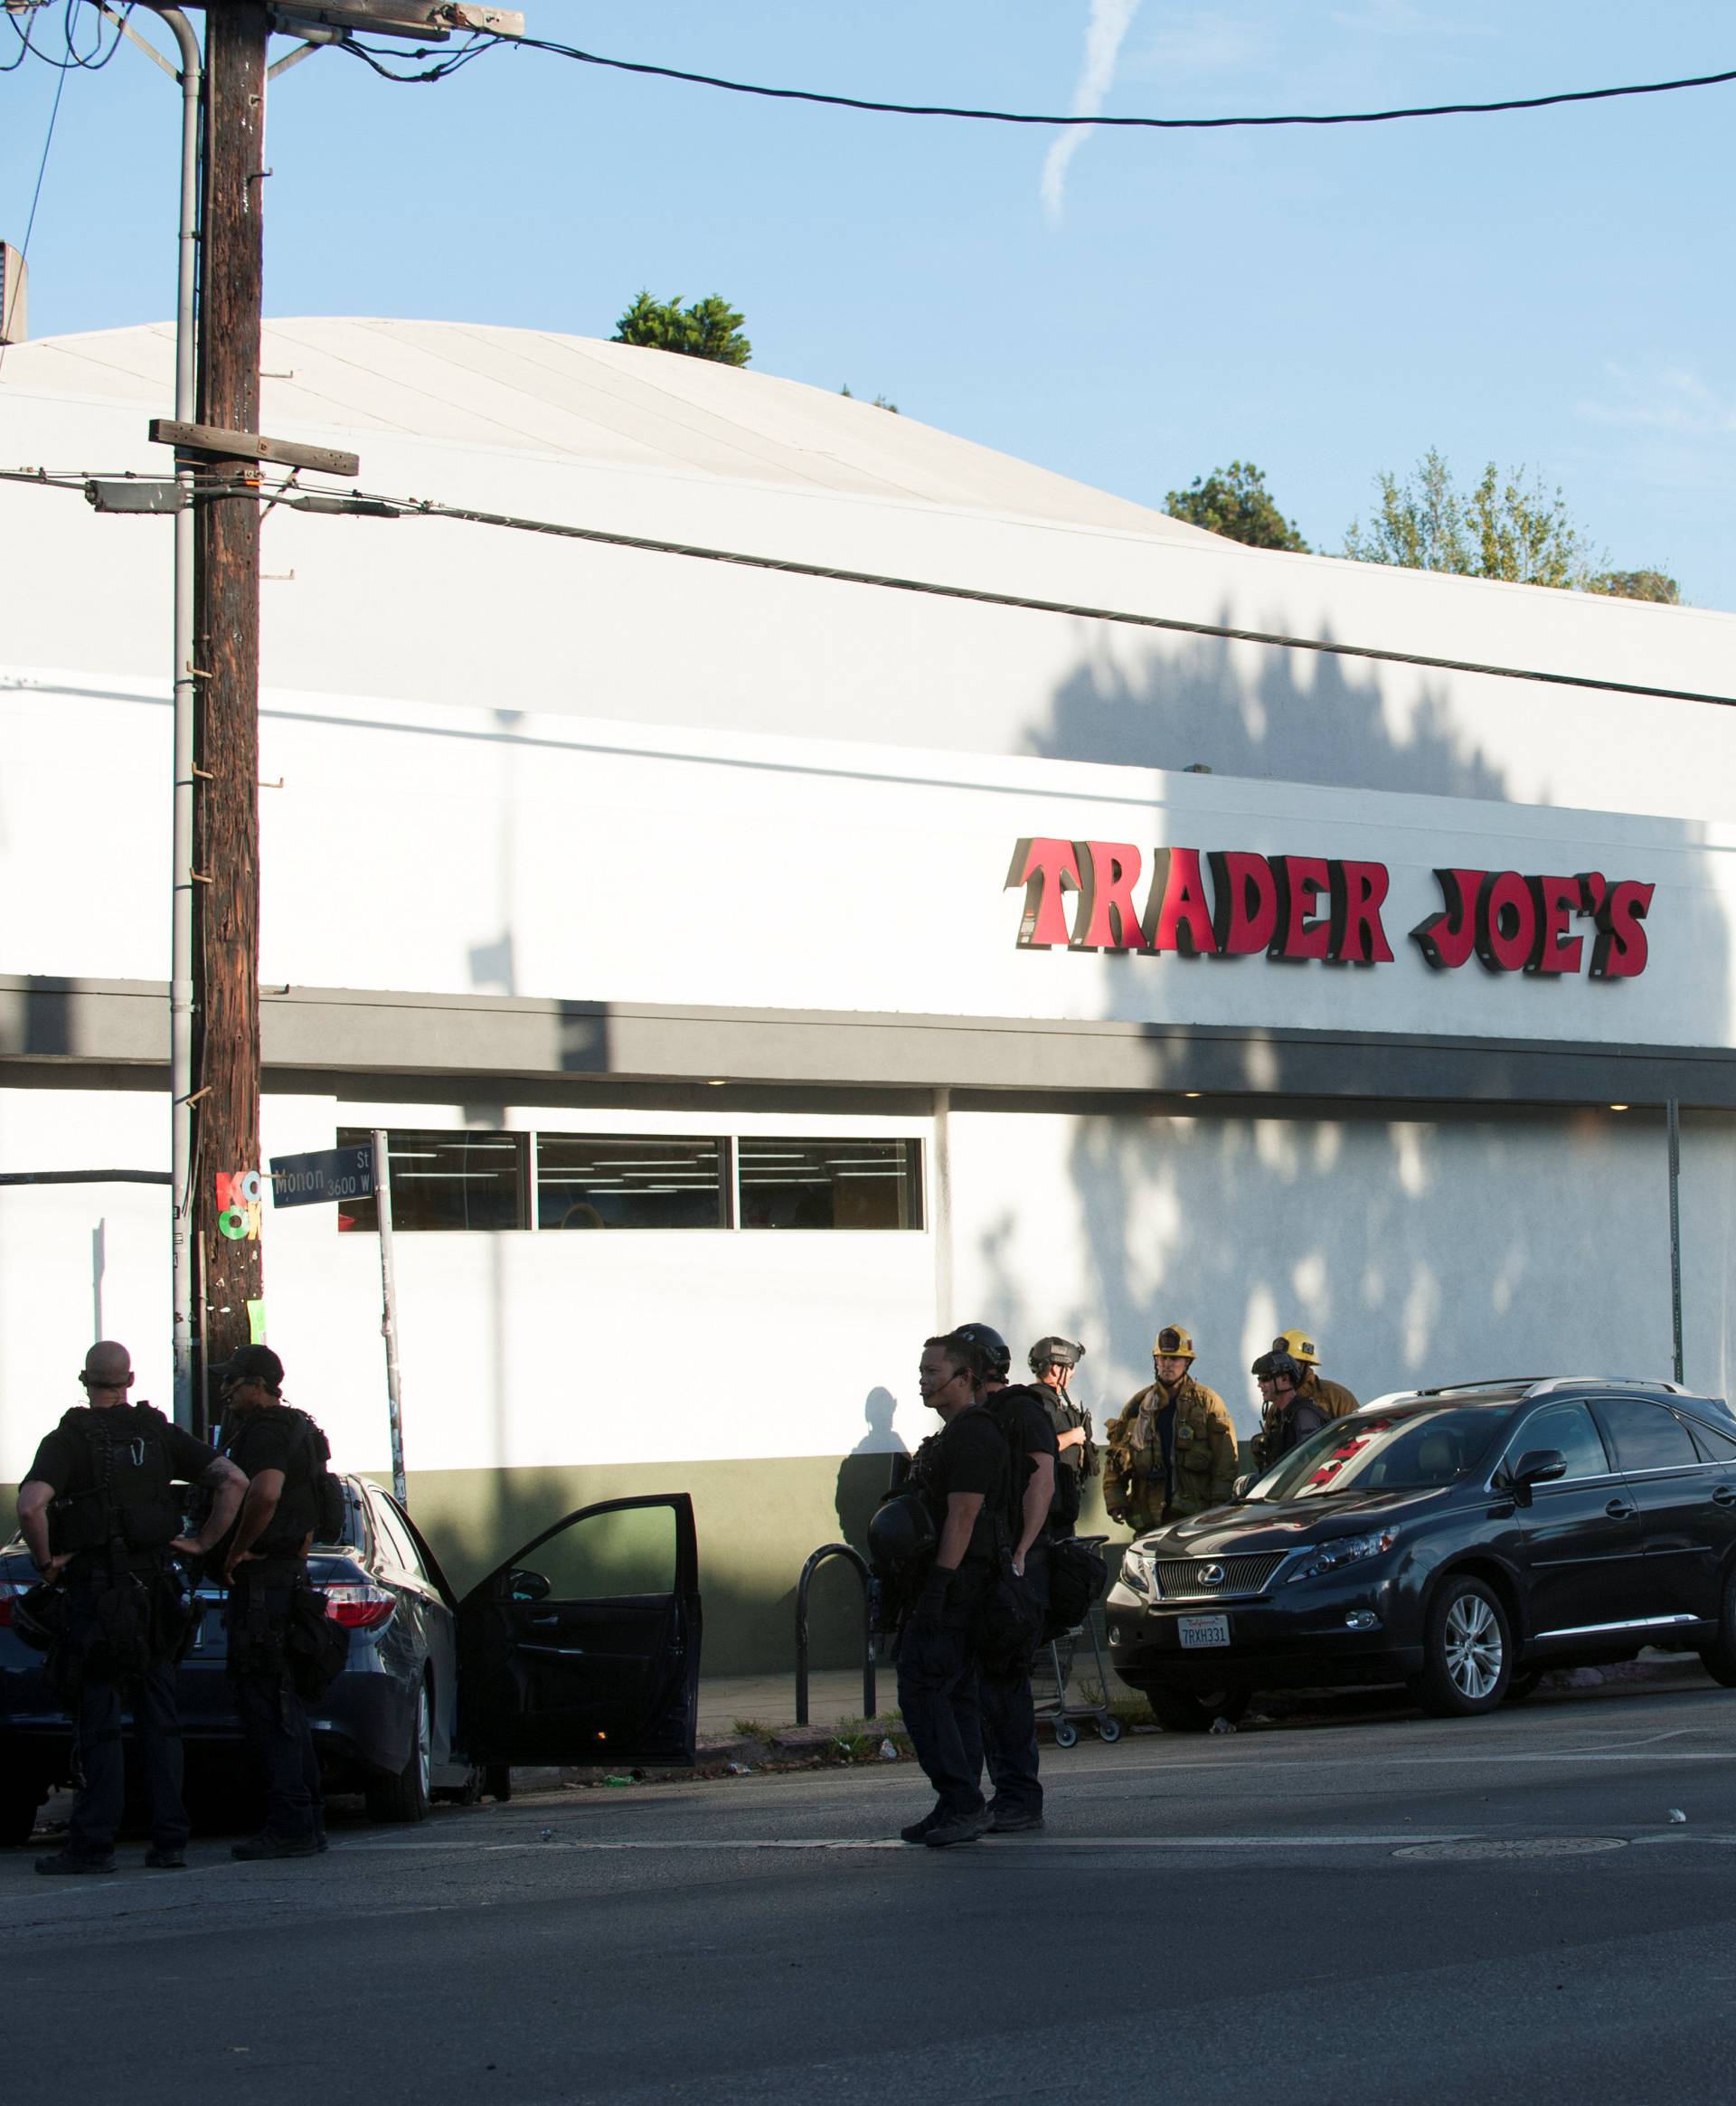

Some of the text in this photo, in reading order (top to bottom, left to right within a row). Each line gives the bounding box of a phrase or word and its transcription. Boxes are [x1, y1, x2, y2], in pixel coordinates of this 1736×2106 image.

[1004, 837, 1656, 978] TRADER JOE'S
[357, 1150, 370, 1169] St
[275, 1169, 371, 1196] Monon 3600 W
[1182, 1627, 1227, 1644] 7RXH331
